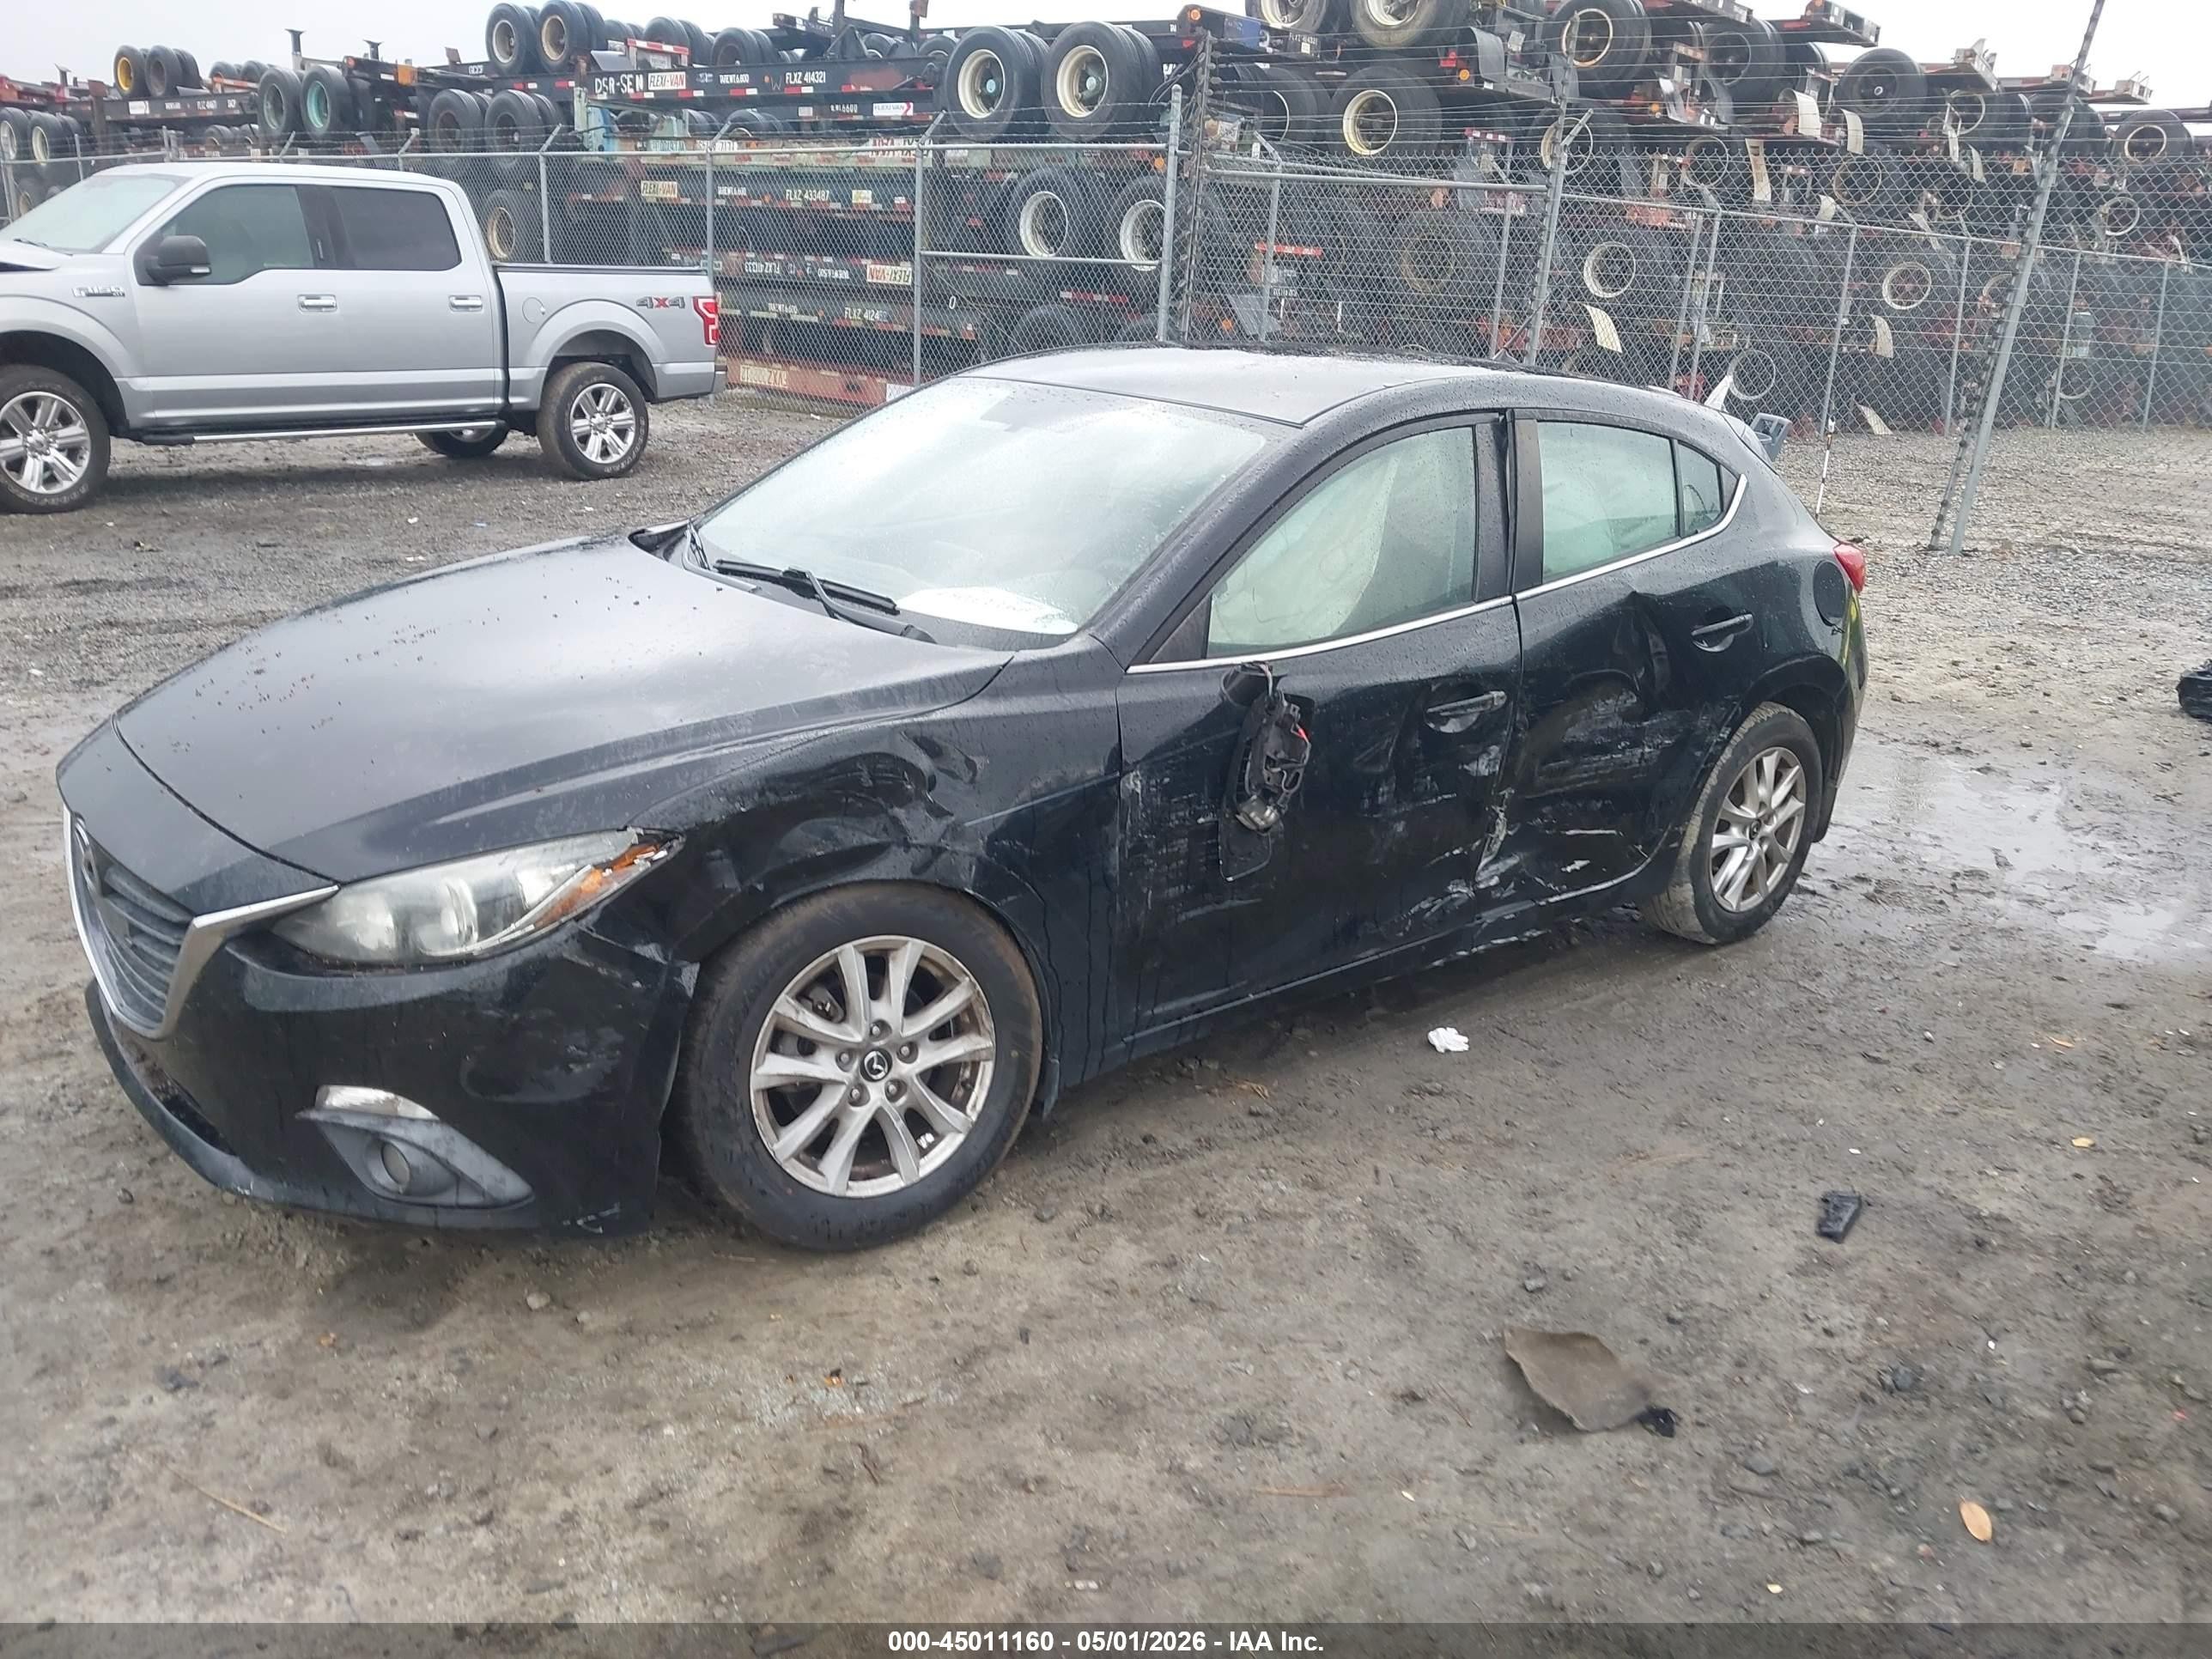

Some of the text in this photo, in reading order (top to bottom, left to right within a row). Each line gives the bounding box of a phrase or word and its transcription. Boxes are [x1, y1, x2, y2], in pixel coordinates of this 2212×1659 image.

[650, 73, 684, 88] FLEXI-VAN
[785, 71, 826, 84] FLXZ 414321
[642, 182, 676, 197] FLEXI-VAN
[786, 189, 830, 201] FLXZ 433487
[765, 262, 780, 274] FLXZ
[868, 265, 910, 283] FLEXI-VAN
[845, 307, 862, 320] FLXZ
